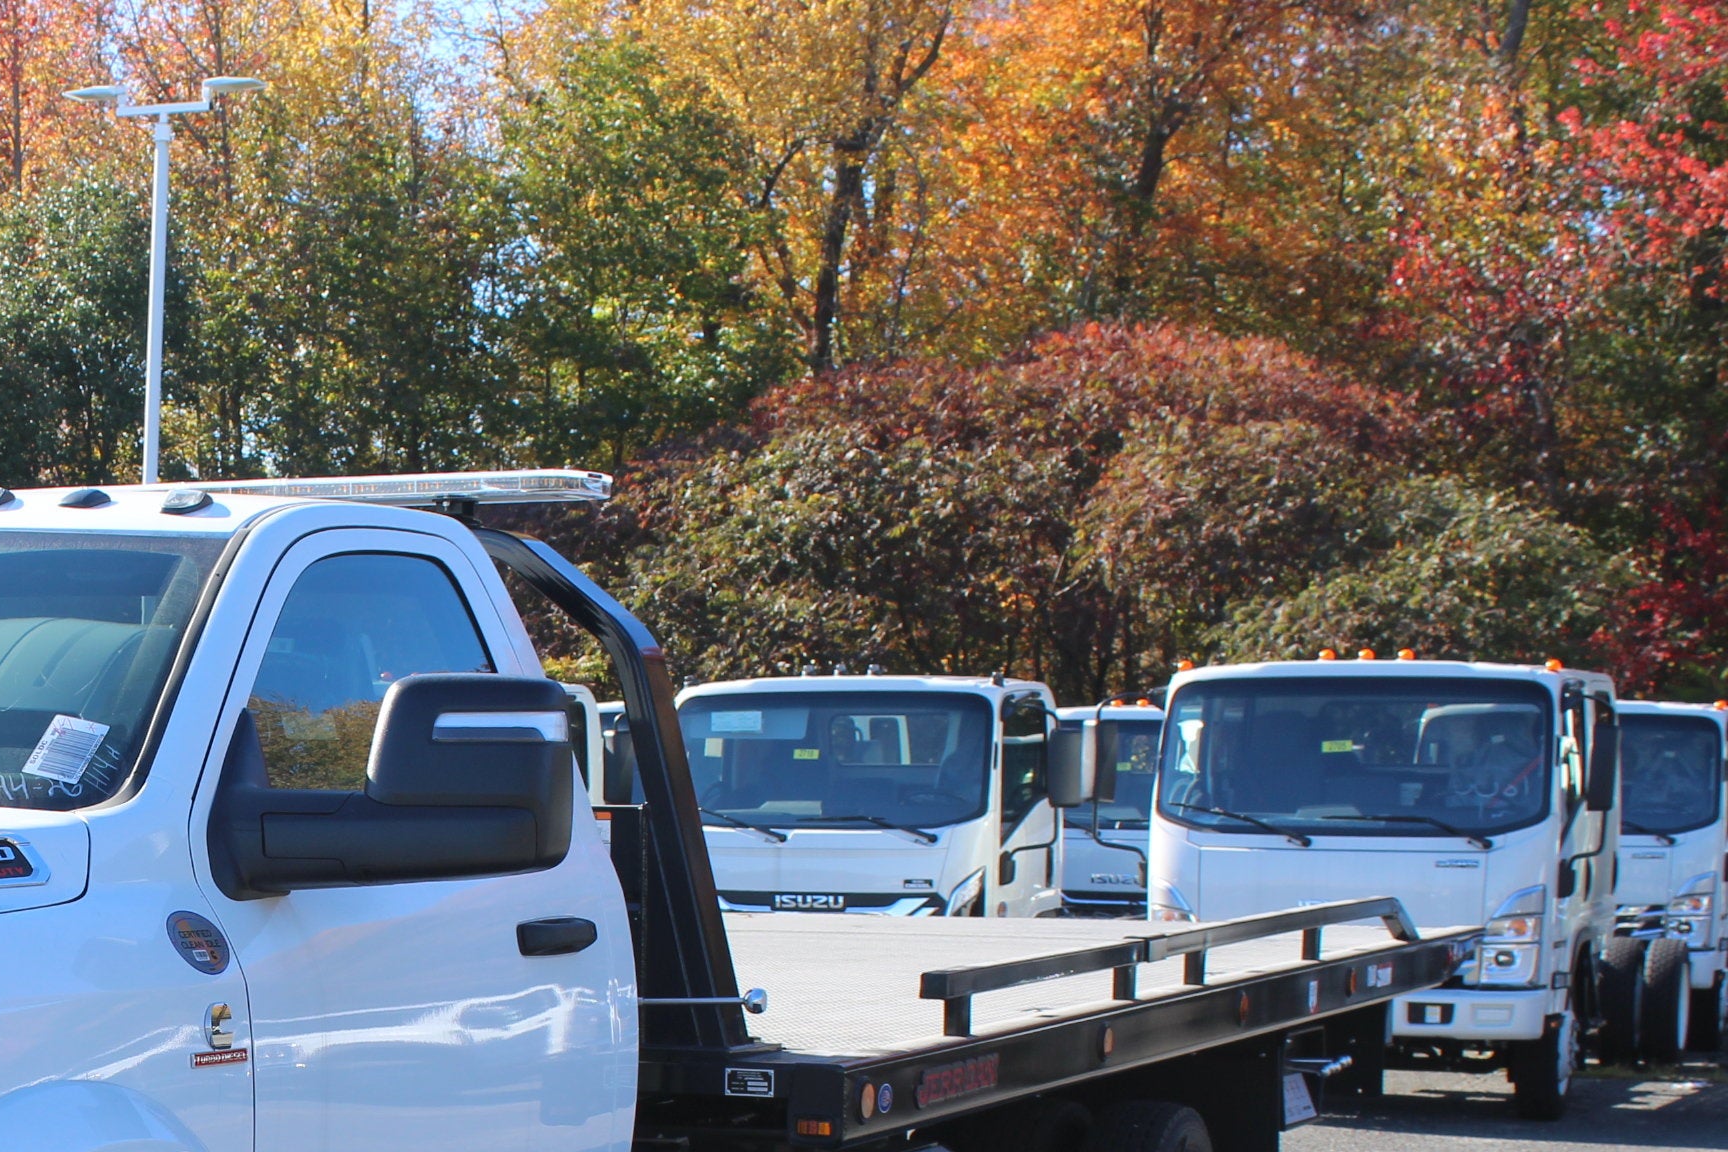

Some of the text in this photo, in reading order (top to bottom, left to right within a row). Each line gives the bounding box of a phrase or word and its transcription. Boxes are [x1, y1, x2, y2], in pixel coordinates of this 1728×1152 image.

[774, 894, 845, 909] ISUZU
[178, 929, 212, 938] CERTIFIED
[181, 940, 204, 949] CLEAN
[196, 1051, 246, 1064] TURBO DIESEL
